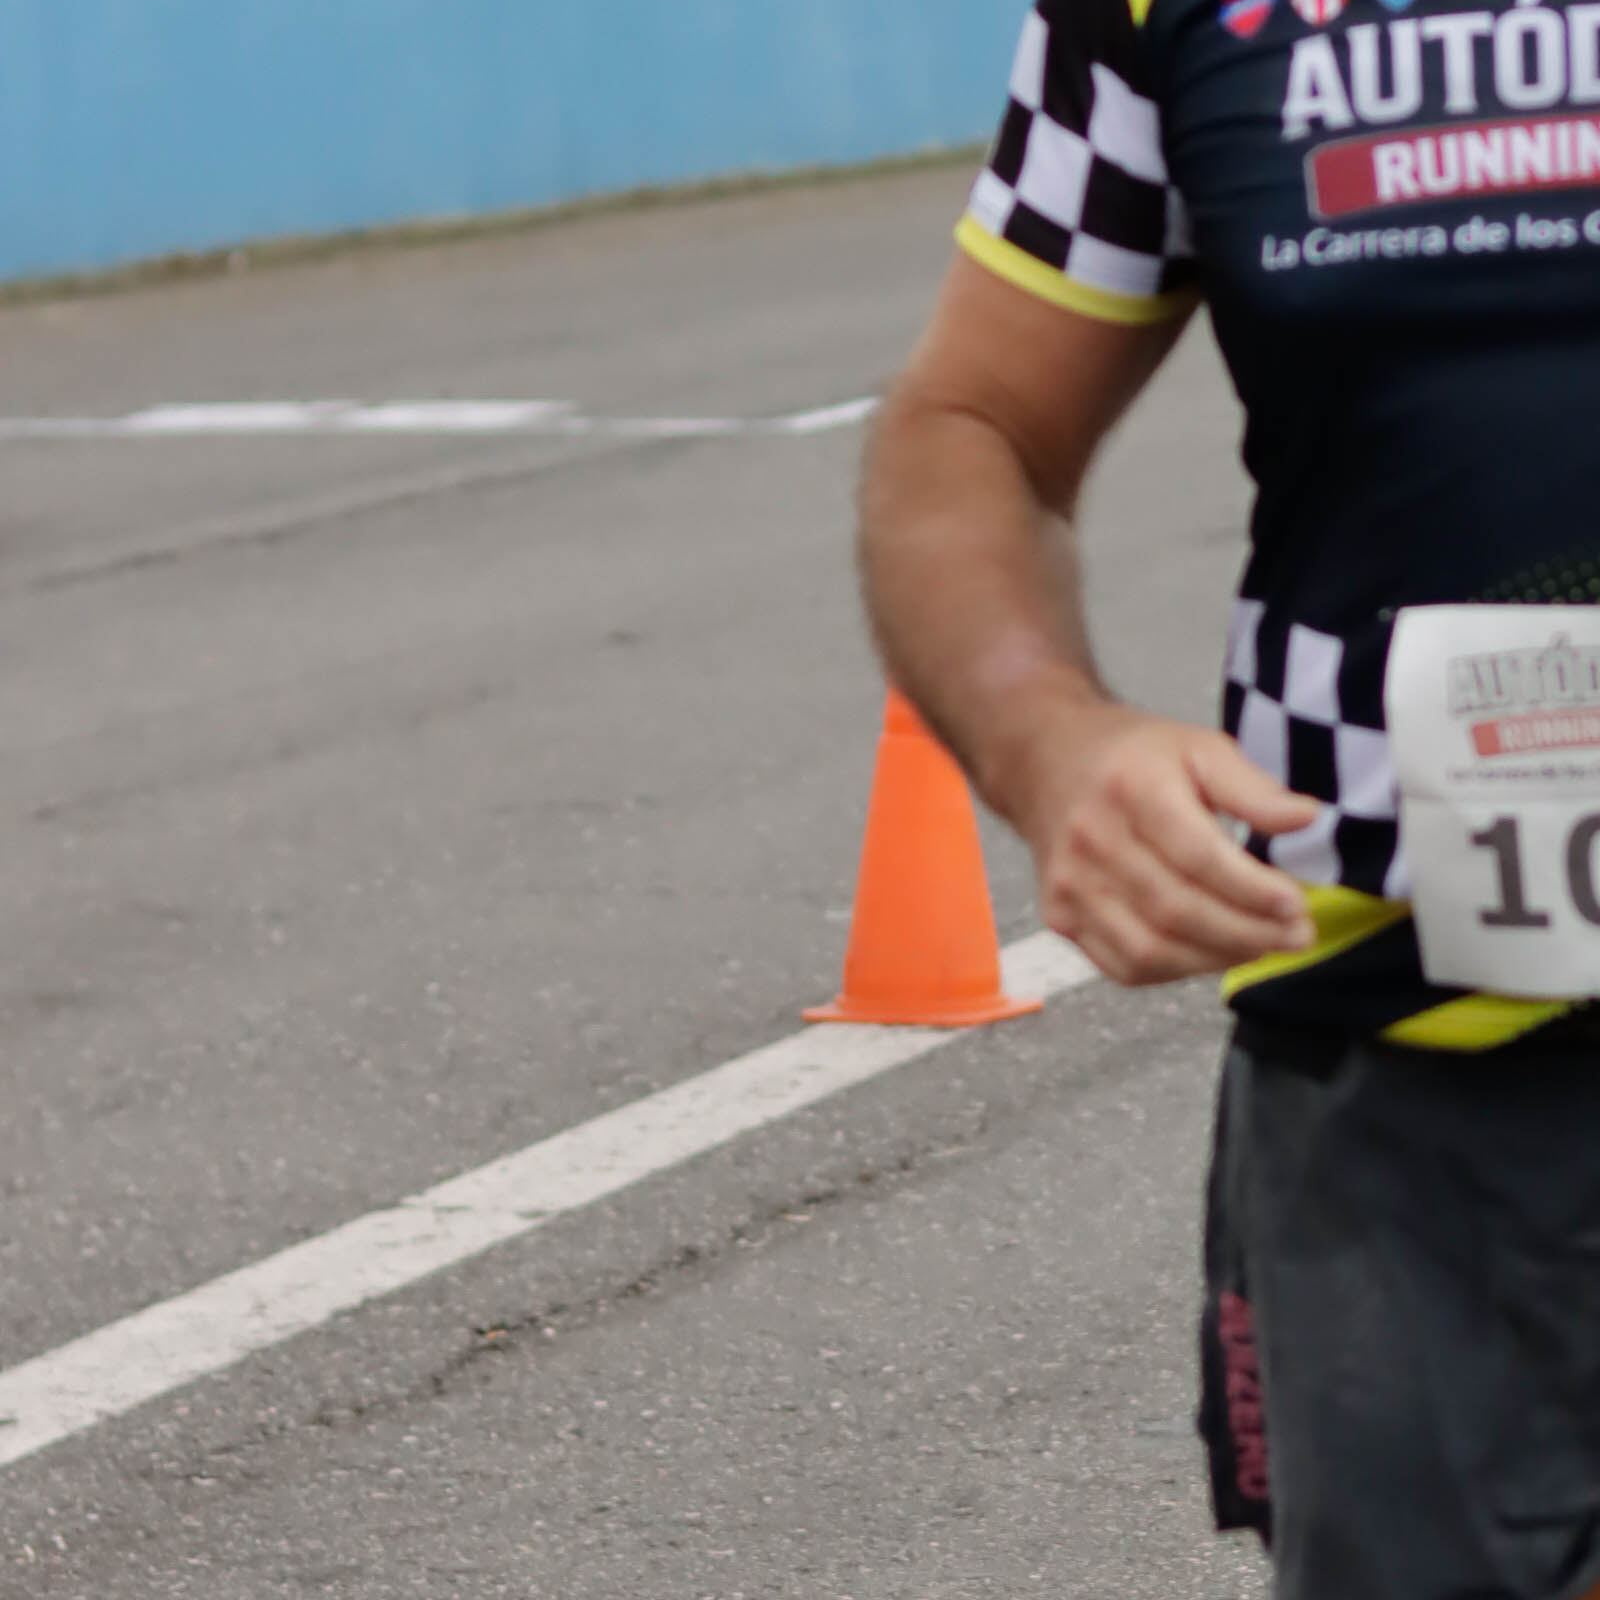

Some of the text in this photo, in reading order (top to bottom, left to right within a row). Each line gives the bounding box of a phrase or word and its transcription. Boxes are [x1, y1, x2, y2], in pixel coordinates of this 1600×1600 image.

[1261, 233, 1300, 271] La
[1302, 226, 1448, 266] Carrera
[1453, 214, 1511, 254] de
[1515, 211, 1579, 250] los
